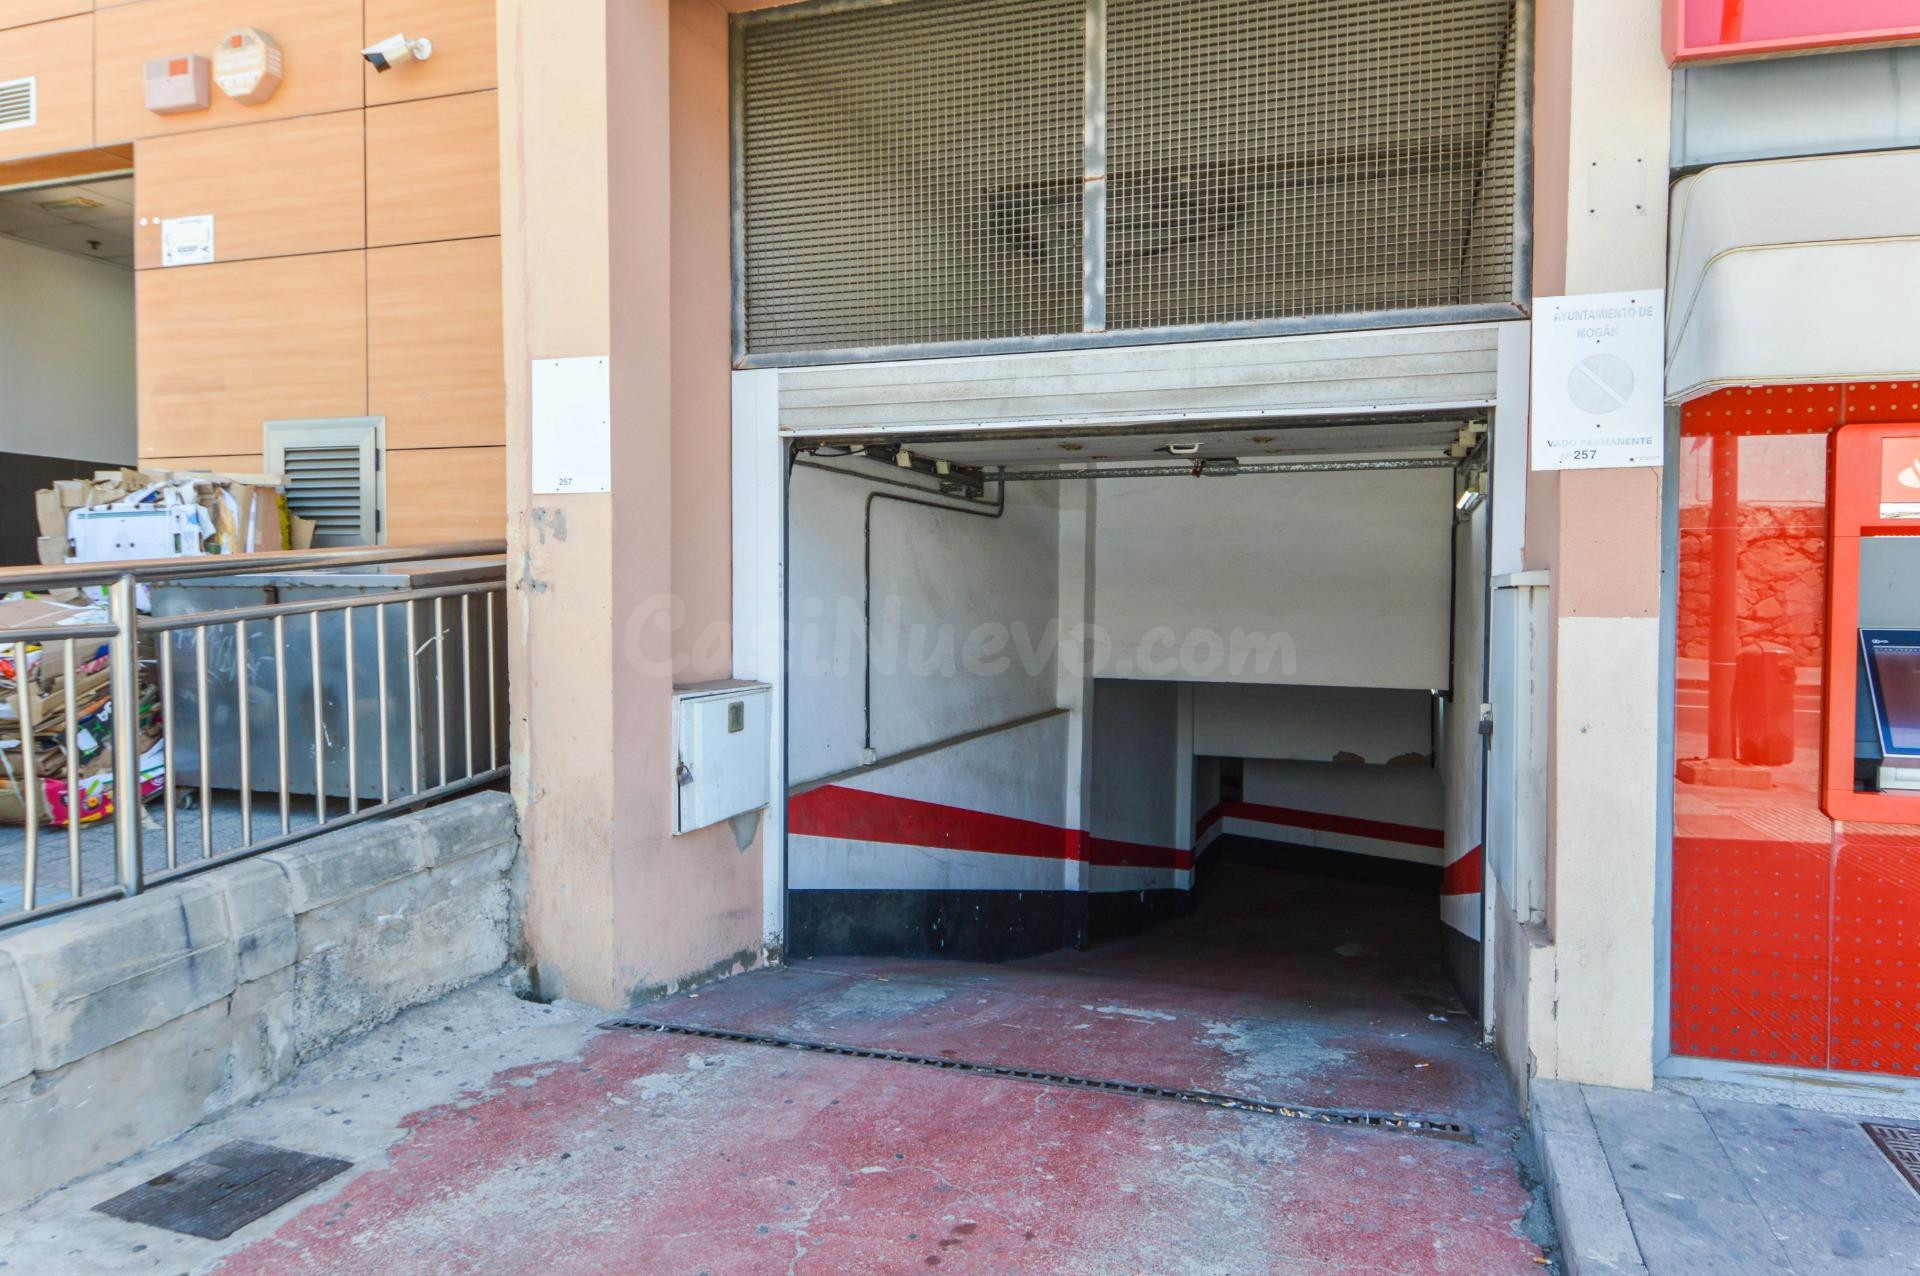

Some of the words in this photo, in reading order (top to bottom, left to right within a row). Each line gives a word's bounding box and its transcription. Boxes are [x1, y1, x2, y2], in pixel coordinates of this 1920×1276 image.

[1553, 307, 1636, 322] AYUNTAMIENTO
[1639, 305, 1653, 318] DE
[1547, 440, 1576, 448] VADO
[1573, 449, 1597, 460] 257
[558, 477, 573, 486] 257
